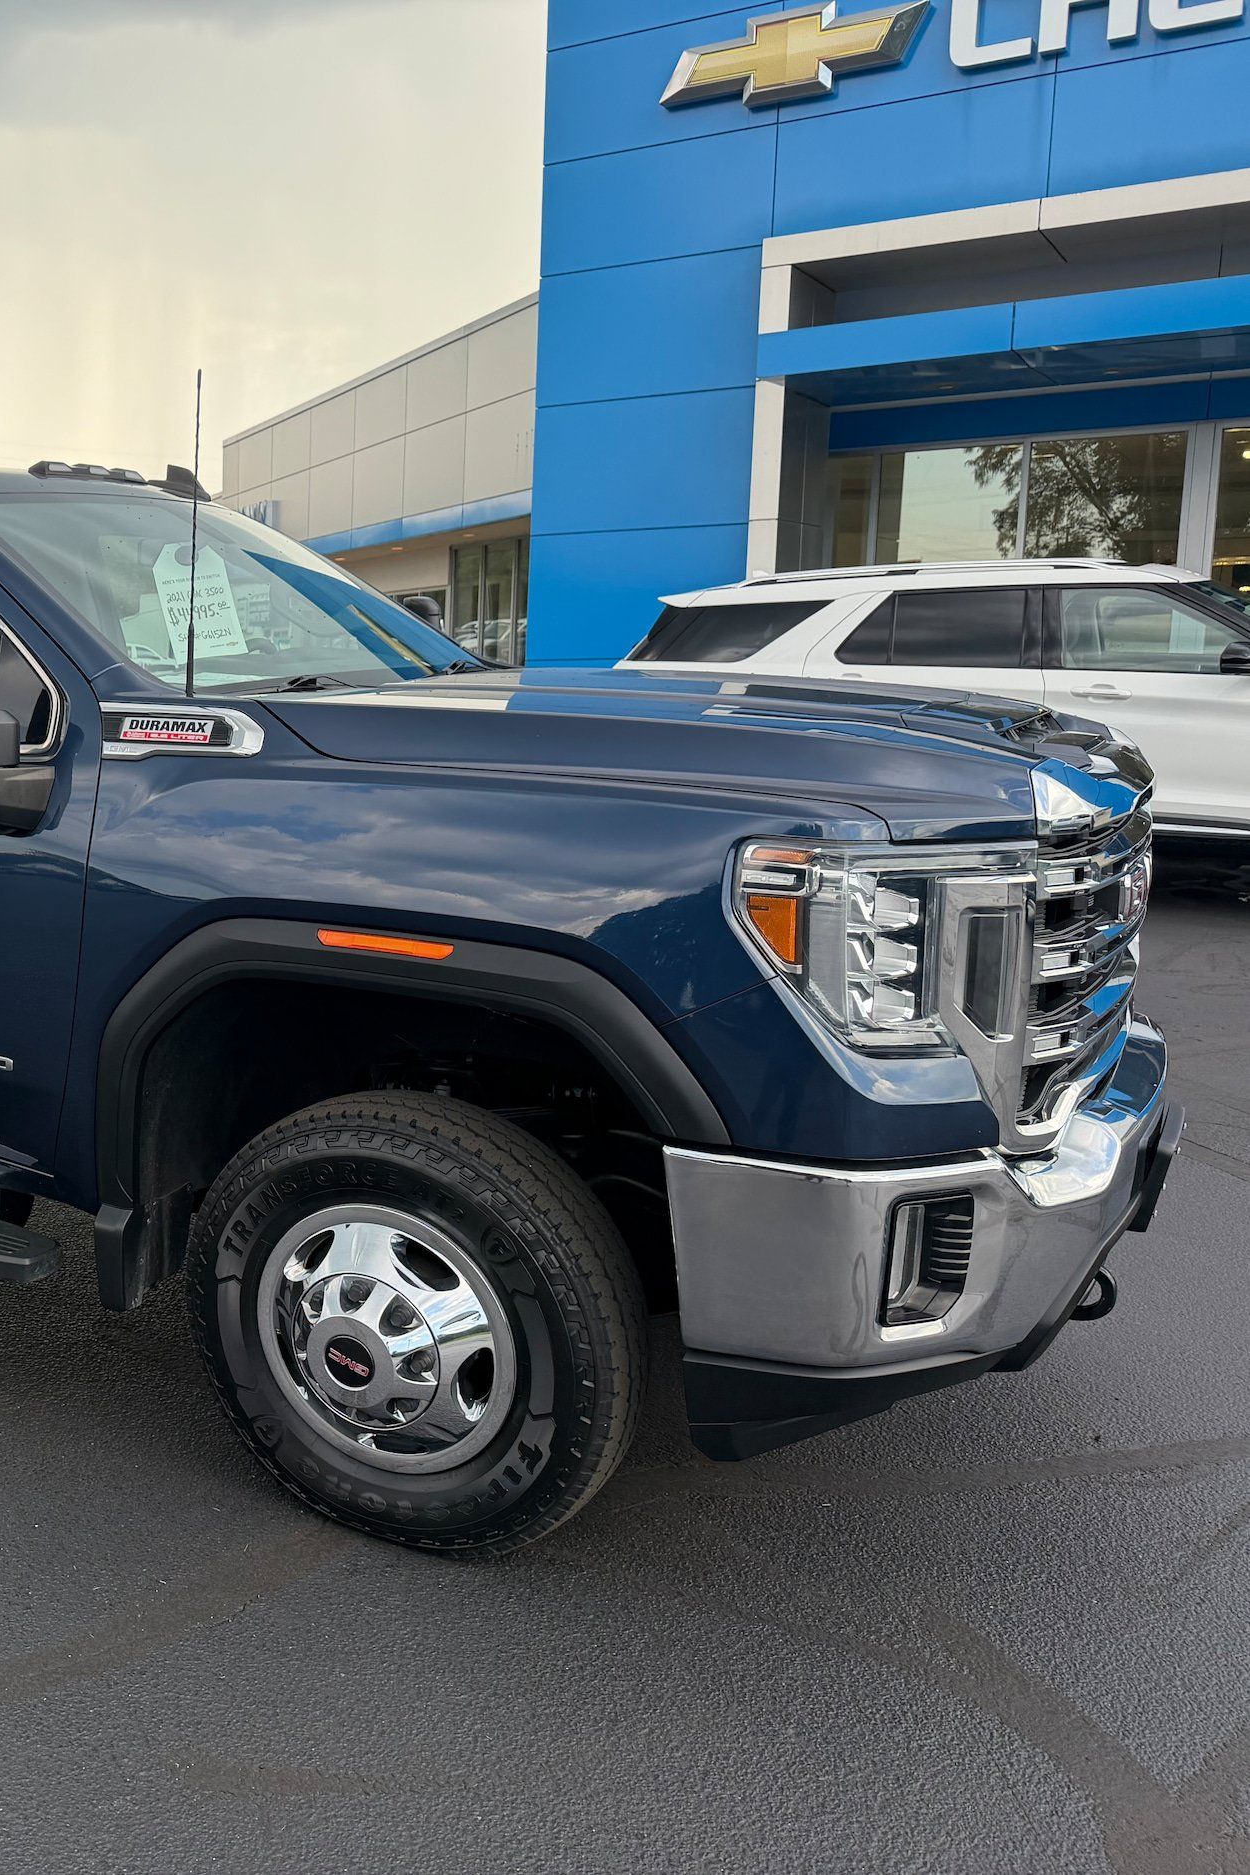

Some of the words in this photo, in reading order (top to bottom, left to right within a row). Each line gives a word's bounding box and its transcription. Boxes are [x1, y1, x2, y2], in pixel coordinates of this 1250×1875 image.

[166, 591, 185, 603] 2021
[204, 586, 224, 597] 3500
[128, 719, 208, 734] DURAMAX
[223, 1159, 399, 1259] TRANSFORCE
[328, 1347, 370, 1378] GMC
